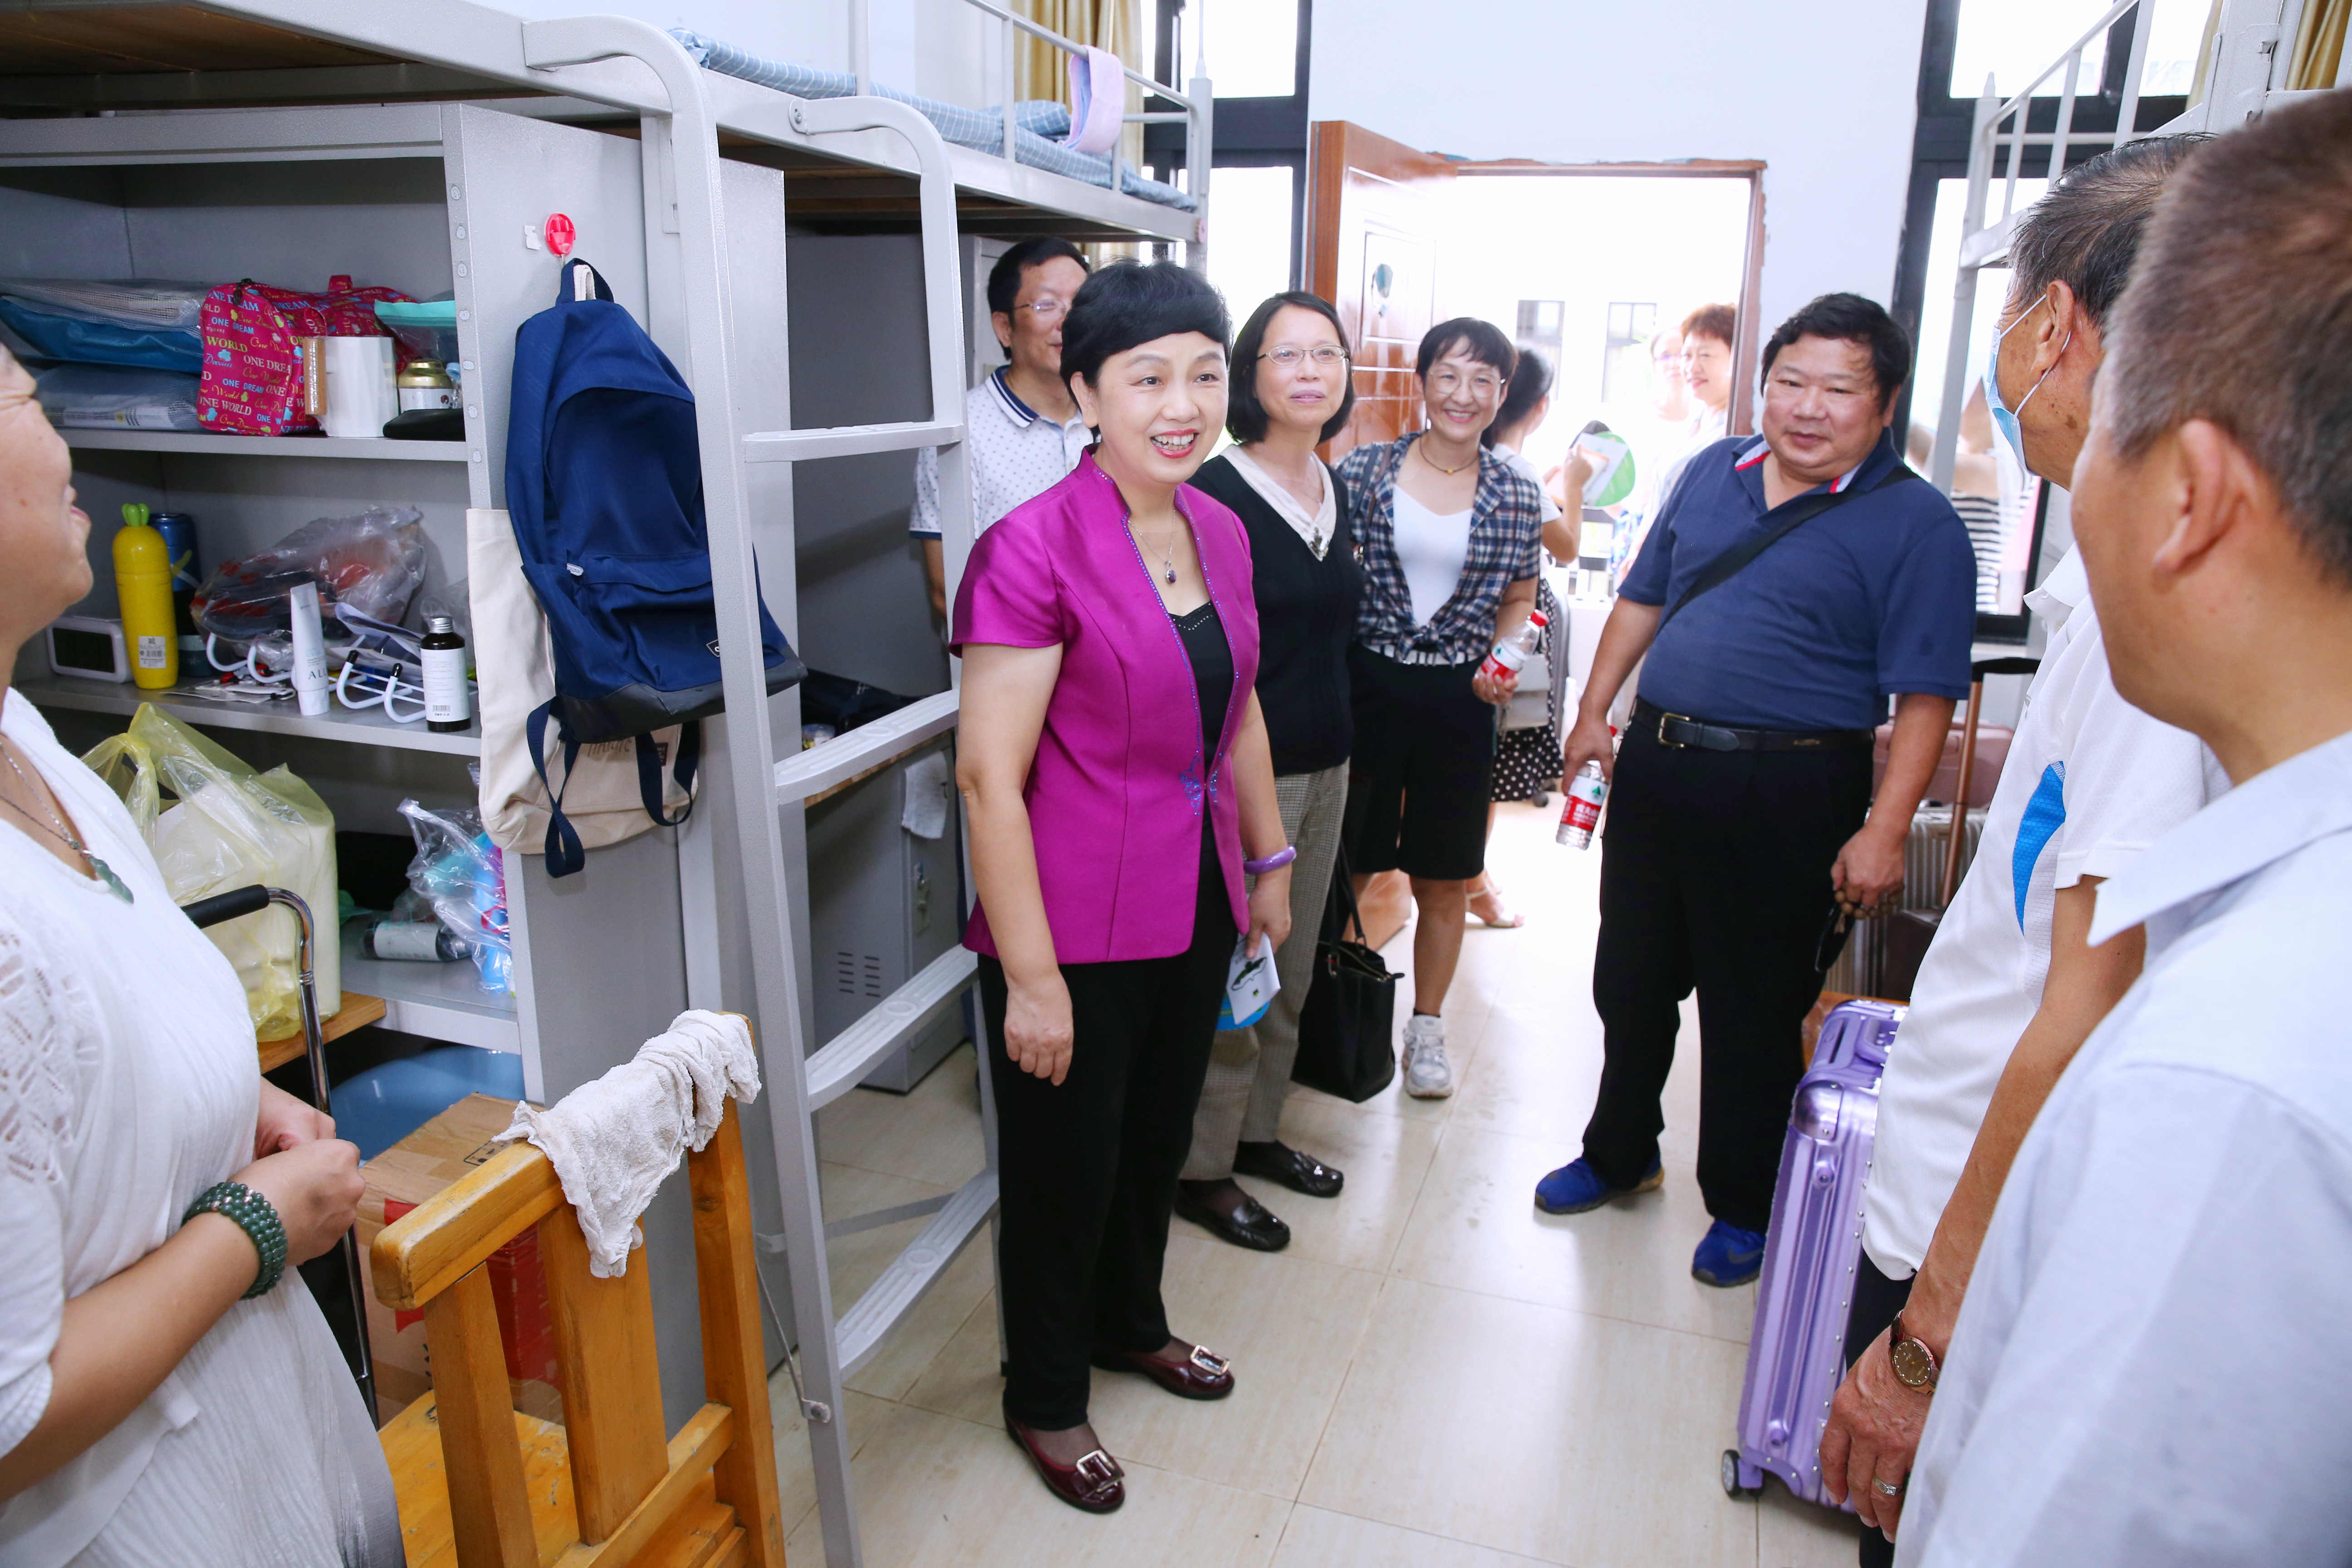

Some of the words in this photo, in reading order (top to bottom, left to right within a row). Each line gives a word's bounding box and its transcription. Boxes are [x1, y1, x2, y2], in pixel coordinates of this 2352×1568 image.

[227, 294, 260, 312] DAM
[211, 317, 229, 327] ONE
[233, 322, 255, 334] DREAM
[206, 336, 248, 353] WORLD
[250, 337, 268, 348] One
[244, 355, 265, 367] ONE
[243, 367, 258, 379] One
[211, 385, 240, 400] World
[222, 378, 240, 388] ONE
[243, 382, 264, 394] DREAM
[266, 385, 286, 397] ONE
[221, 400, 252, 416] WORLD
[219, 414, 235, 426] One
[257, 413, 271, 424] ONE
